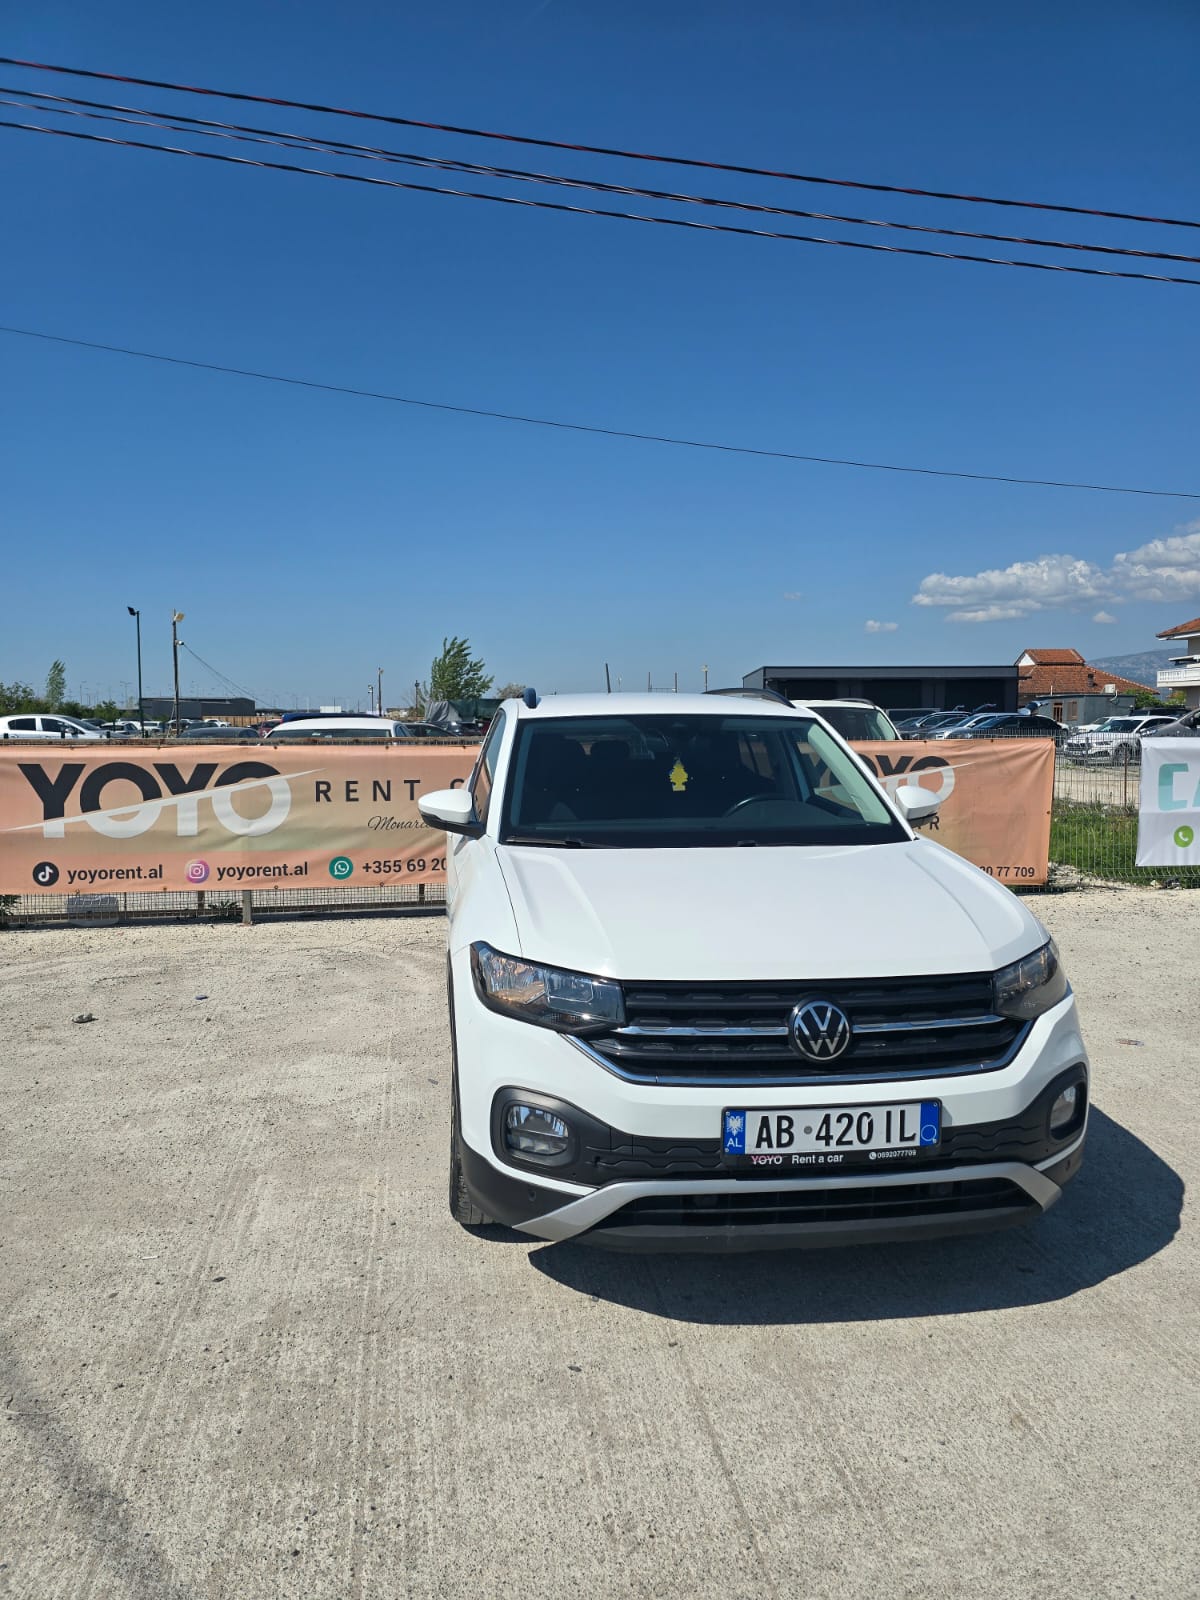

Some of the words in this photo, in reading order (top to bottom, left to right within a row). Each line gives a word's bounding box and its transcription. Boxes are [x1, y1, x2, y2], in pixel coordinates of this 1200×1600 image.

[315, 779, 421, 802] RENT
[17, 761, 292, 838] YOYO
[67, 864, 163, 884] yoyorent.al
[217, 862, 308, 881] yoyorent.al
[362, 860, 402, 874] +355
[406, 858, 426, 872] 69
[997, 866, 1010, 877] 77
[1014, 866, 1035, 877] 709
[755, 1115, 795, 1149] AB
[815, 1112, 874, 1147] 420
[886, 1109, 917, 1143] IL
[727, 1138, 743, 1148] AL
[751, 1155, 783, 1165] YOYO
[791, 1154, 816, 1165] Rent
[827, 1154, 844, 1164] car
